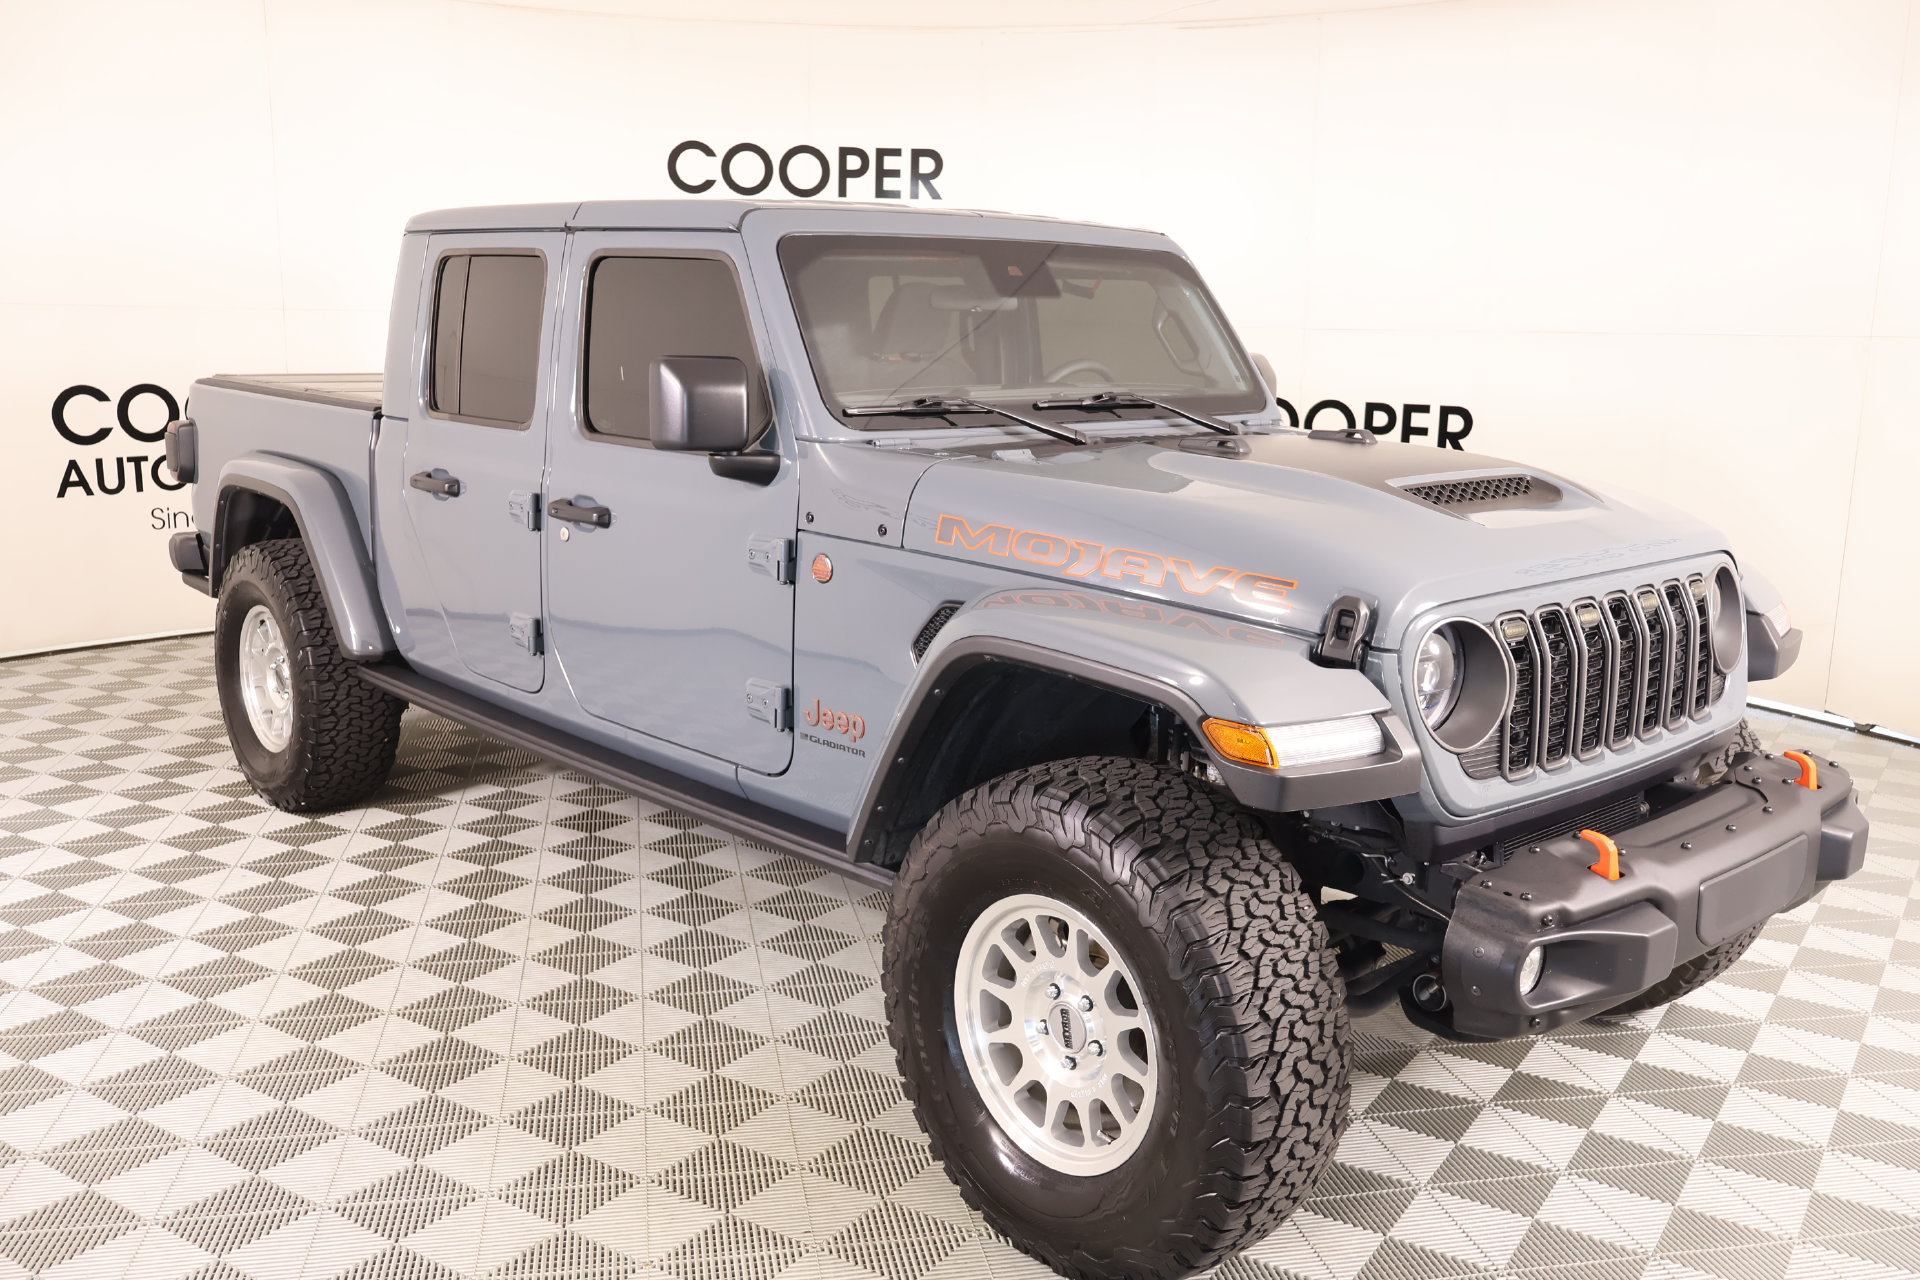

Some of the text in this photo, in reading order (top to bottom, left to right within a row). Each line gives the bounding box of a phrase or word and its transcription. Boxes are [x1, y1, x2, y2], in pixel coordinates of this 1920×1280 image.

[667, 140, 944, 200] COOPER
[51, 383, 191, 445] CO
[151, 507, 195, 530] Sin
[935, 513, 1300, 612] MOJAVE
[803, 697, 866, 743] Jeep
[808, 735, 866, 758] GLADIATOR
